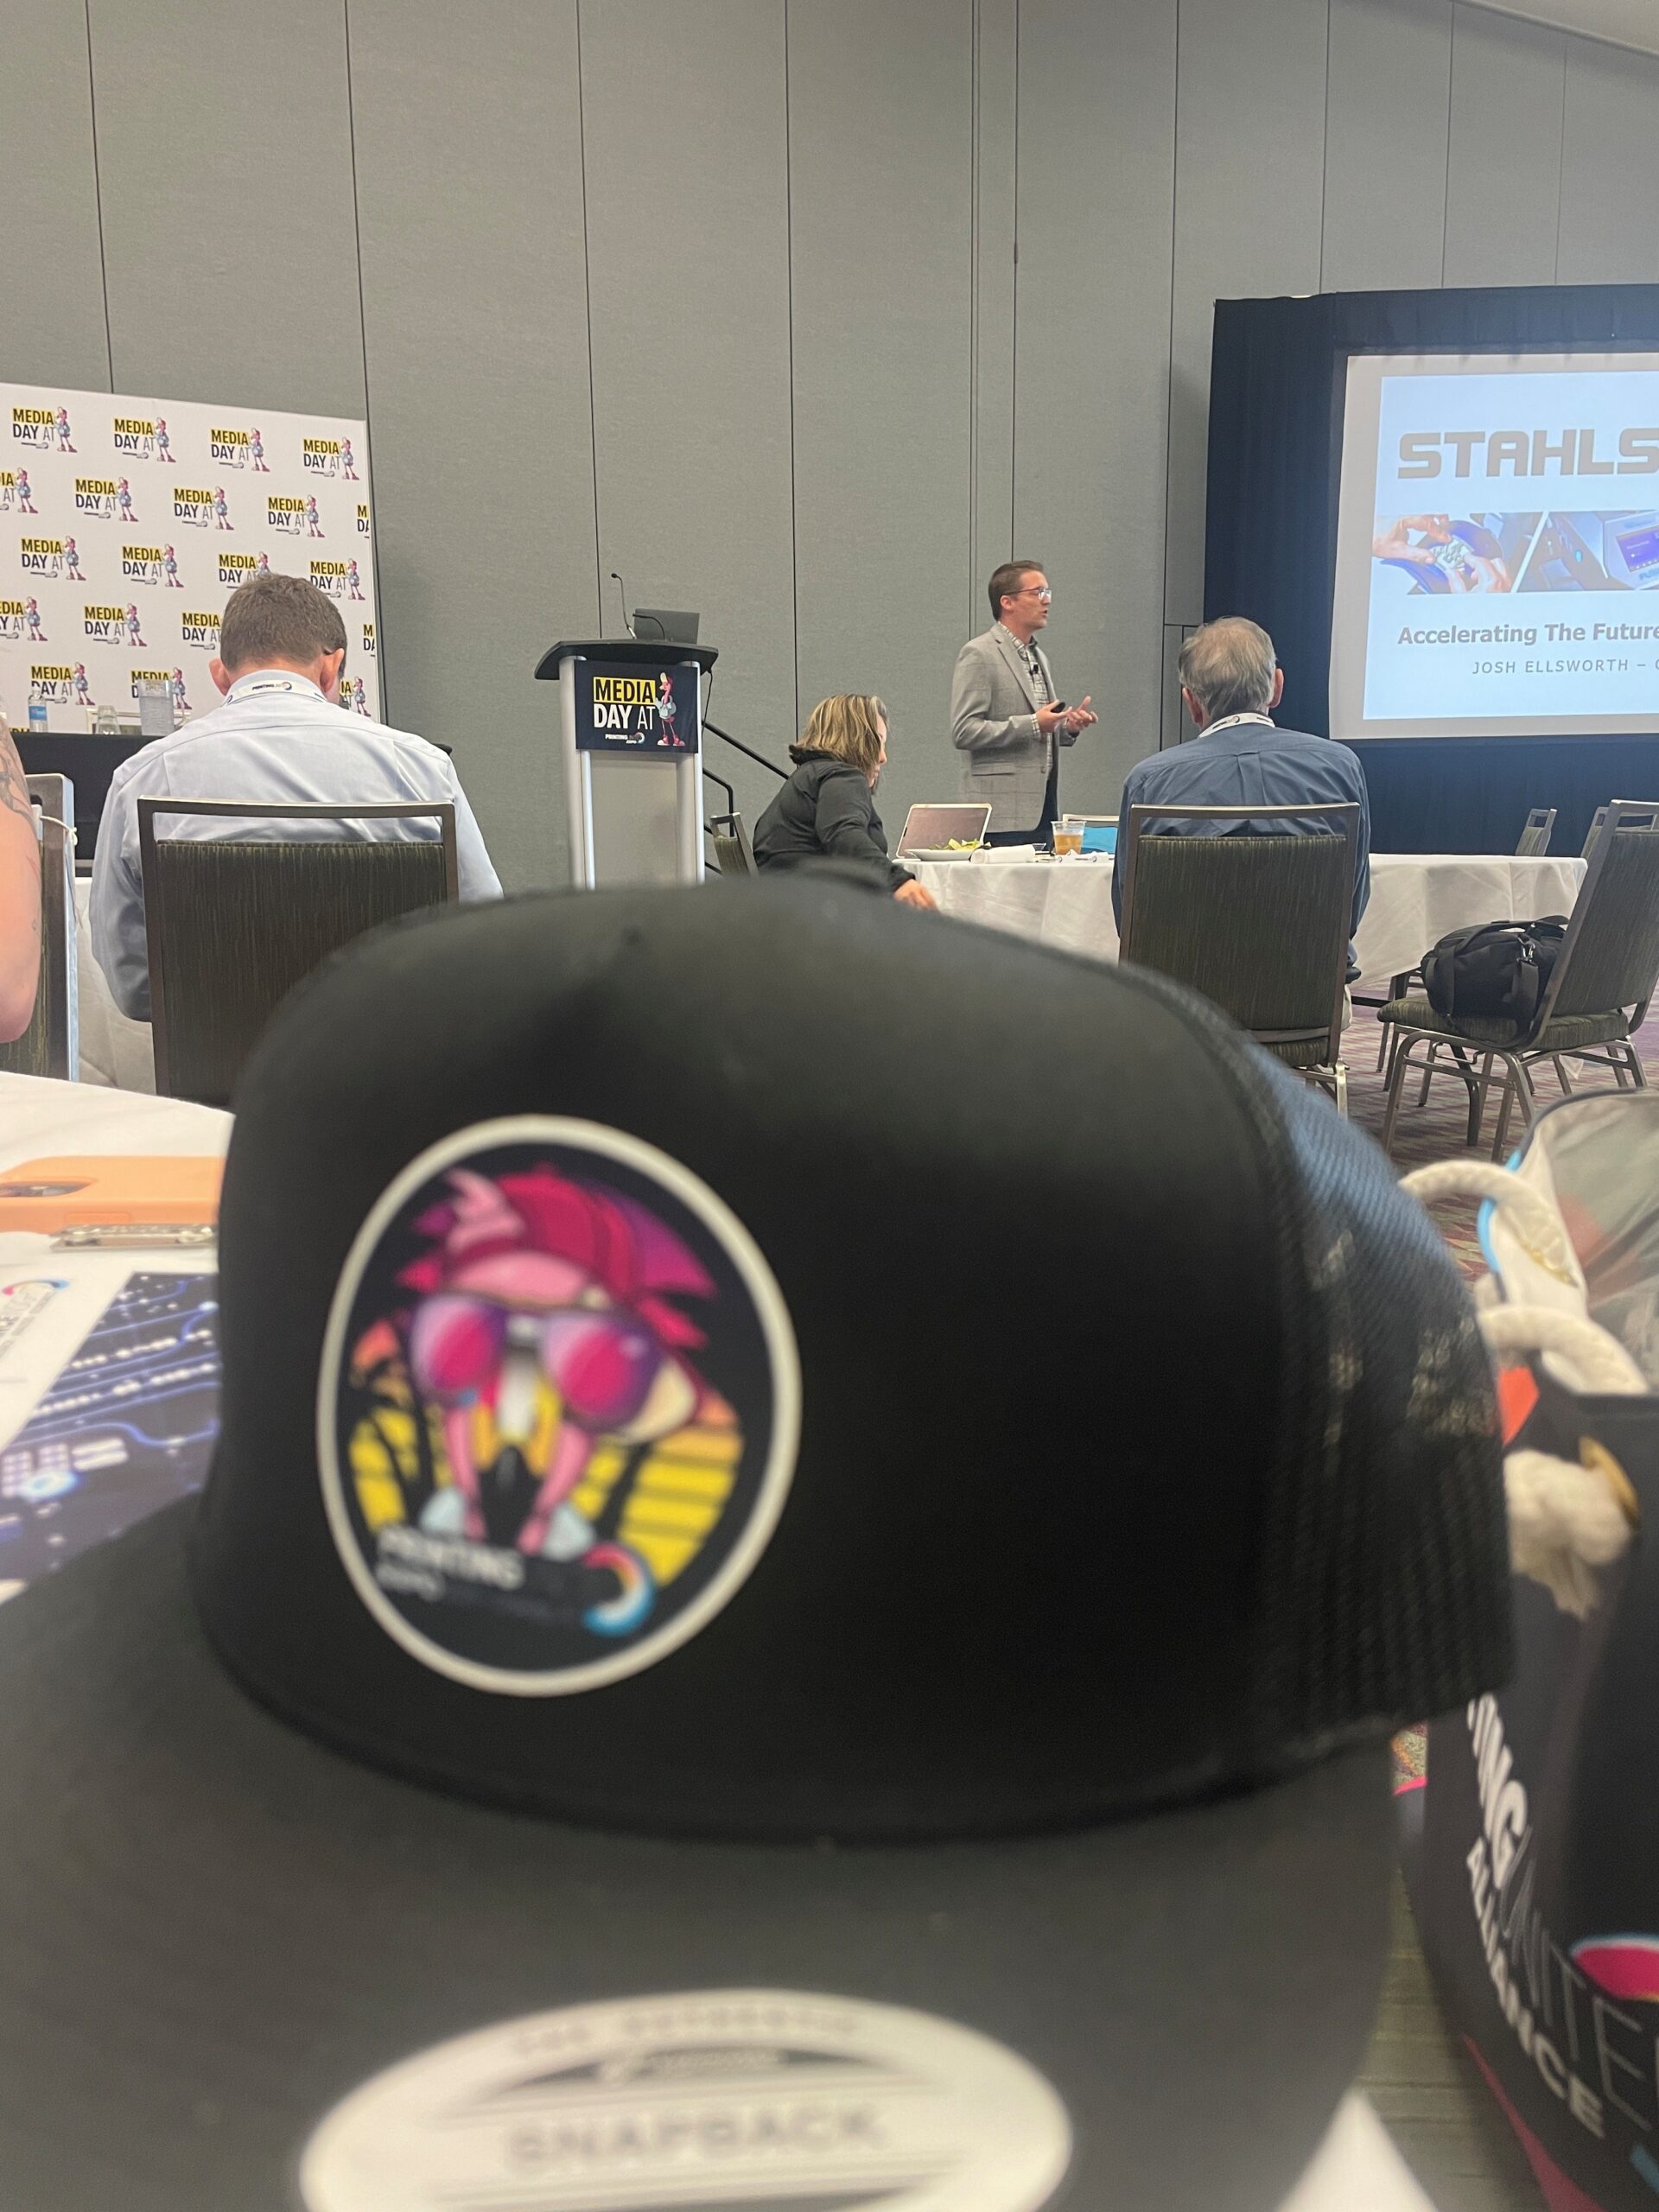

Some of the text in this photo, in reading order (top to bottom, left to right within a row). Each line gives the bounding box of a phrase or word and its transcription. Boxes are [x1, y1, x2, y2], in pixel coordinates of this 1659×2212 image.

[13, 409, 54, 424] MEDIA
[13, 423, 55, 442] DAY AT
[114, 419, 154, 435] MEDIA
[114, 434, 155, 451] DAY AT
[211, 429, 249, 446] MEDIA
[211, 444, 250, 461] DAY AT
[303, 440, 340, 454] MEDIA
[1397, 428, 1659, 479] STAHLS
[303, 454, 340, 470] DAY AT
[3, 487, 15, 502] AT
[75, 479, 116, 495] MEDIA
[75, 494, 117, 511] DAY AT
[175, 488, 212, 504] MEDIA
[175, 503, 213, 520] DAY AT
[268, 497, 304, 512] MEDIA
[268, 512, 306, 528] DAY AT
[22, 539, 62, 555] MEDIA
[123, 546, 162, 562] MEDIA
[22, 554, 64, 570] DAY AT
[123, 561, 163, 578] DAY AT
[219, 554, 256, 569] MEDIA
[311, 562, 346, 575] MEDIA
[219, 569, 242, 583] DAY
[336, 577, 346, 591] AT
[0, 601, 23, 615] DIA
[85, 606, 124, 621] MEDIA
[13, 617, 26, 632] AT
[182, 613, 220, 627] MEDIA
[85, 620, 126, 637] DAY AT
[182, 627, 207, 642] DAY
[1398, 623, 1659, 646] Accelerating The Future
[31, 666, 72, 680] MEDIA
[1472, 661, 1516, 674] JOSH
[1525, 659, 1628, 673] ELLSWORTH
[62, 682, 73, 696] AT
[594, 678, 654, 703] MEDIA
[594, 703, 657, 730] DAY AT
